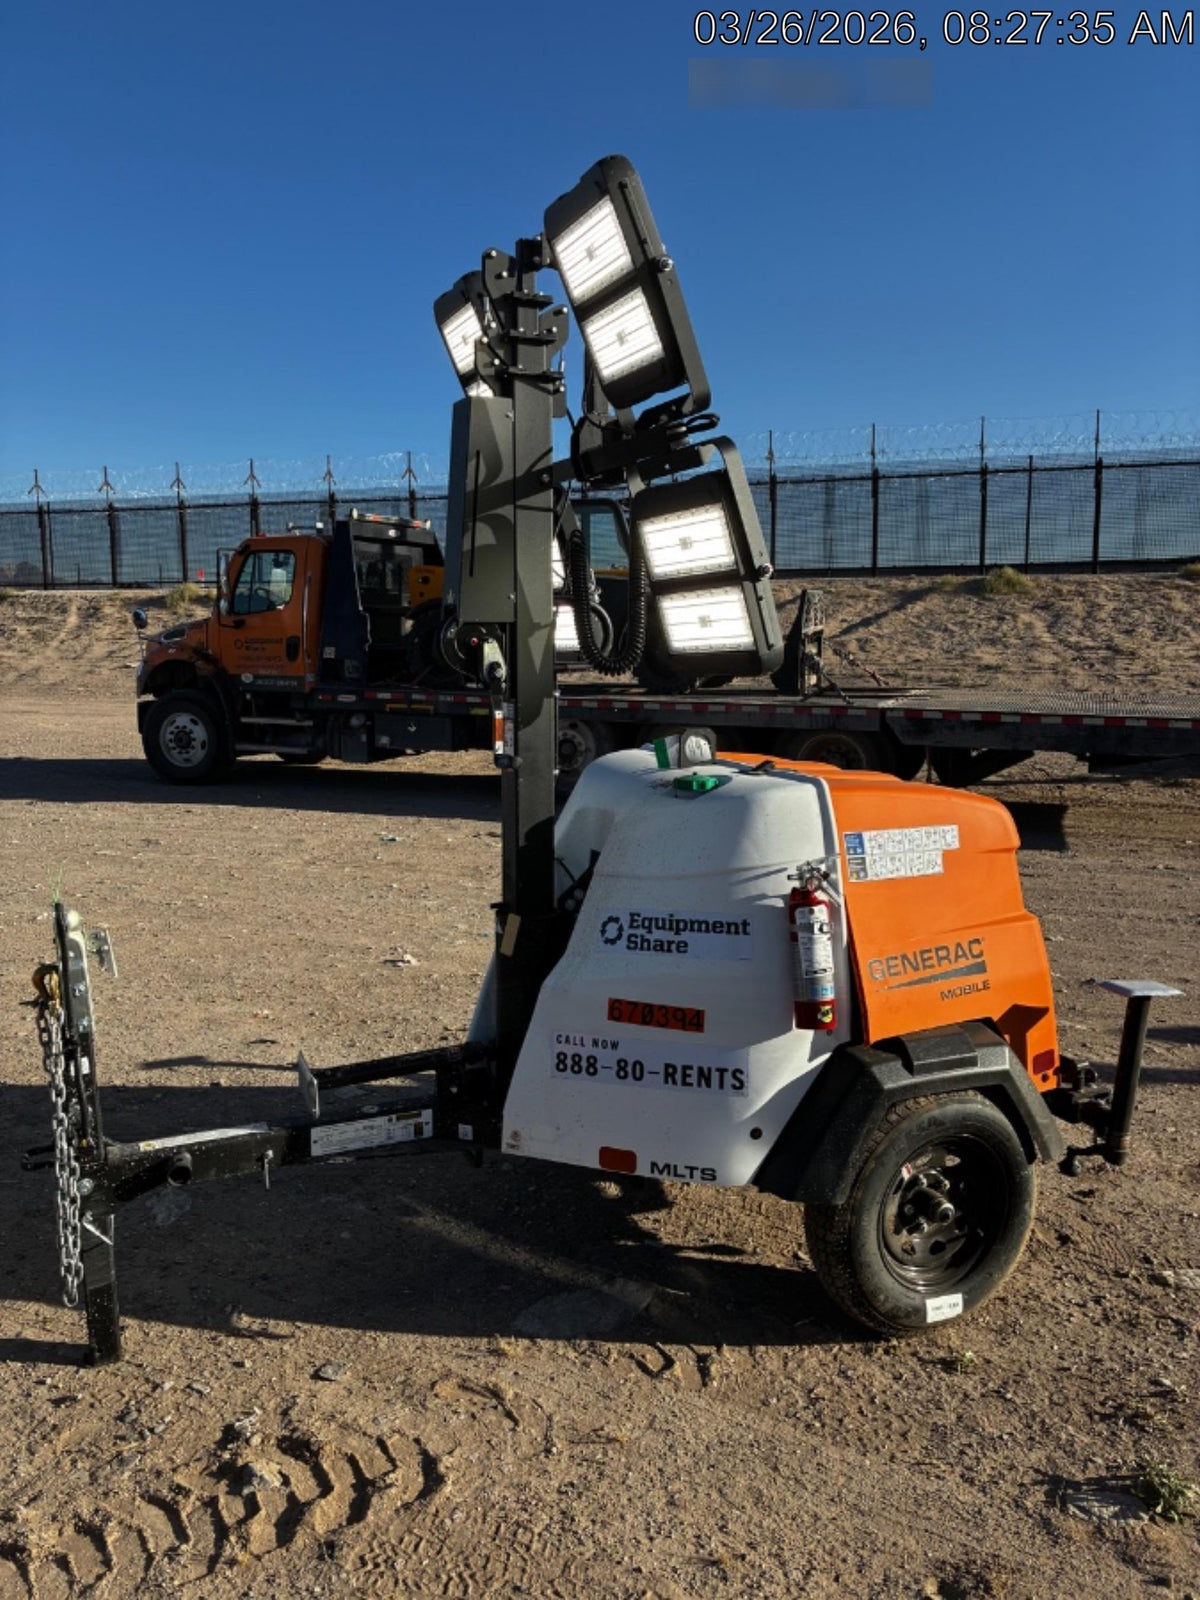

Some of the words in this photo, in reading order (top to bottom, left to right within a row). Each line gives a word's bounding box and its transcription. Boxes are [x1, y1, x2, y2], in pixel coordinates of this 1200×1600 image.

[627, 912, 751, 936] Equipment
[625, 933, 689, 954] Share
[868, 938, 985, 981] GENERAC
[940, 979, 991, 1001] MOBILE
[610, 999, 704, 1031] 670394
[556, 1033, 587, 1048] CALL
[591, 1037, 620, 1050] NOW
[555, 1051, 746, 1091] 888-80-RENTS
[650, 1161, 717, 1182] MLTS
